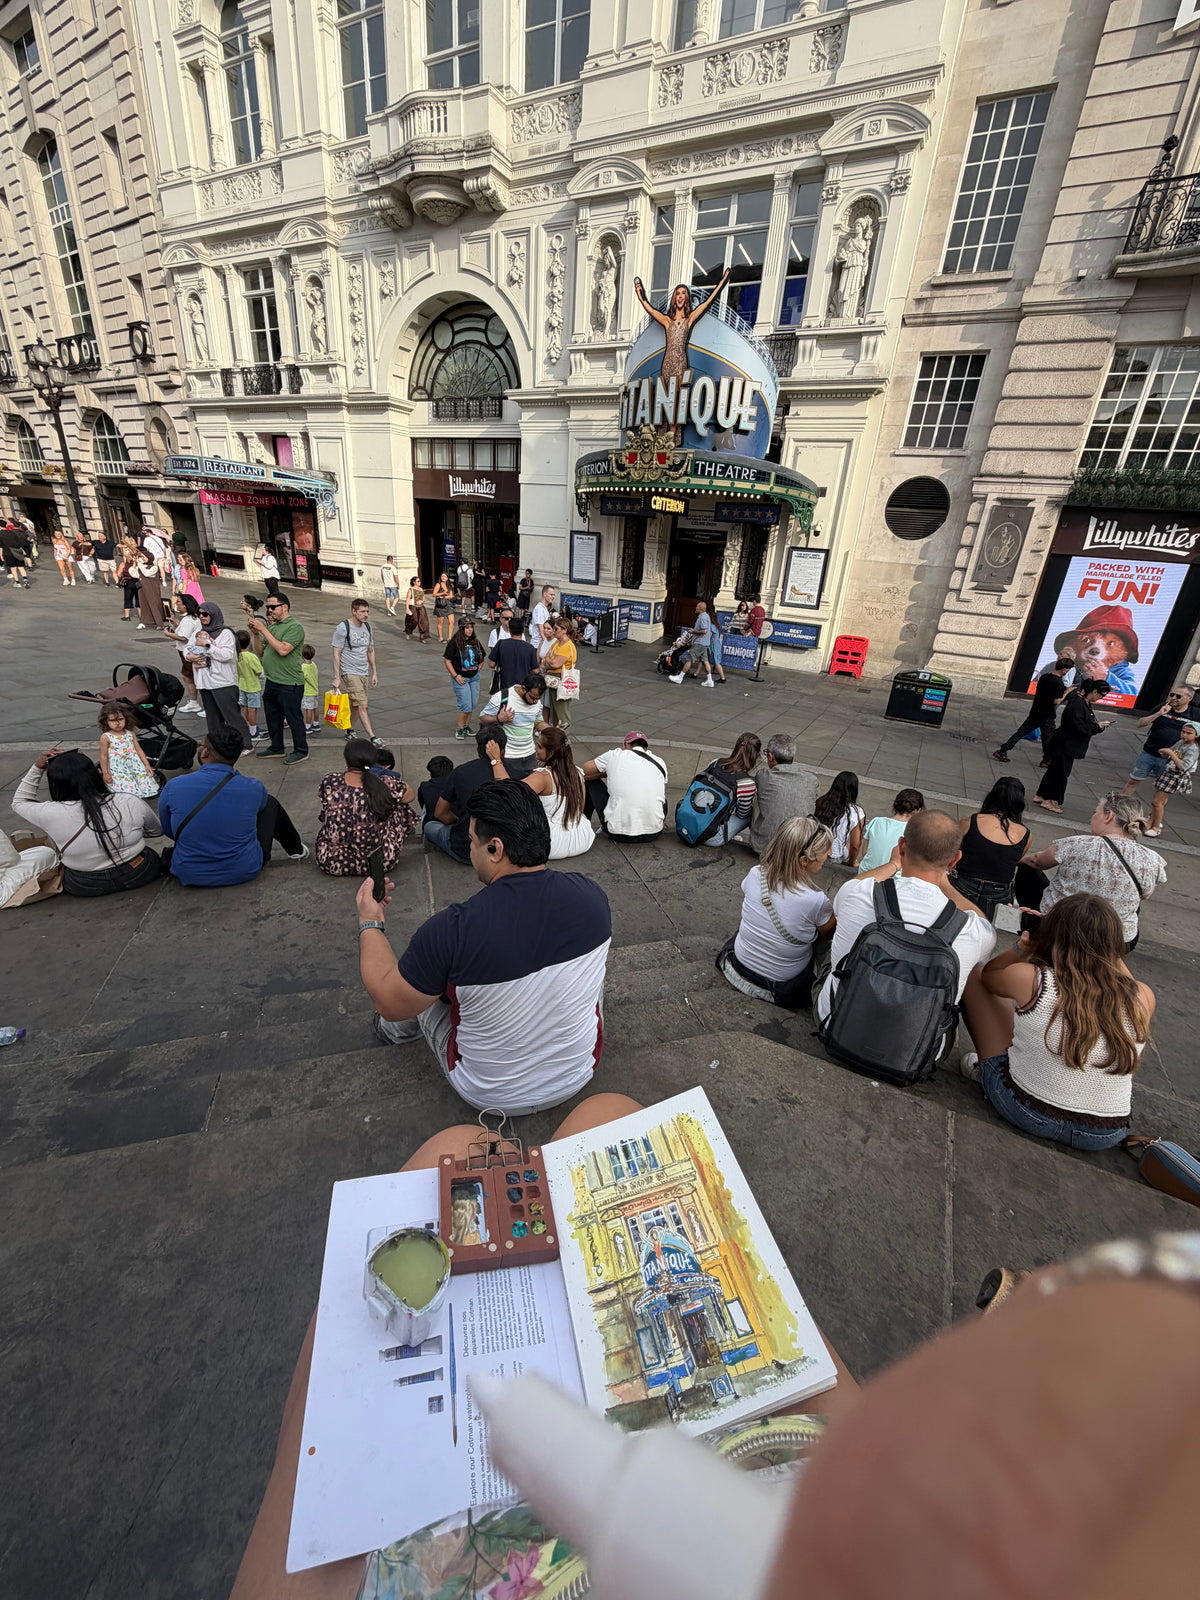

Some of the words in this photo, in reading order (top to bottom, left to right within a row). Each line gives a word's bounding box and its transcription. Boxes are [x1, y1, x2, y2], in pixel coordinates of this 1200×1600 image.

[206, 461, 263, 476] RESTAURANT
[577, 461, 608, 477] CRITERION
[696, 461, 757, 481] THEATRE
[448, 474, 497, 499] Lillywhites
[205, 492, 243, 503] MASALA
[247, 495, 270, 506] ZONE
[288, 497, 309, 508] ZONE
[651, 495, 685, 514] CRITERION
[1083, 515, 1200, 556] Lillywhites
[1085, 570, 1134, 580] MARMALADE
[1136, 574, 1162, 582] FILLED
[1088, 563, 1131, 573] PACKED
[1135, 565, 1165, 575] WITH
[1077, 578, 1160, 605] FUN!
[774, 631, 816, 641] ENTERTAINMENT
[469, 1324, 478, 1355] aquarelles
[467, 1421, 475, 1455] Cotman
[470, 1472, 478, 1506] Explore
